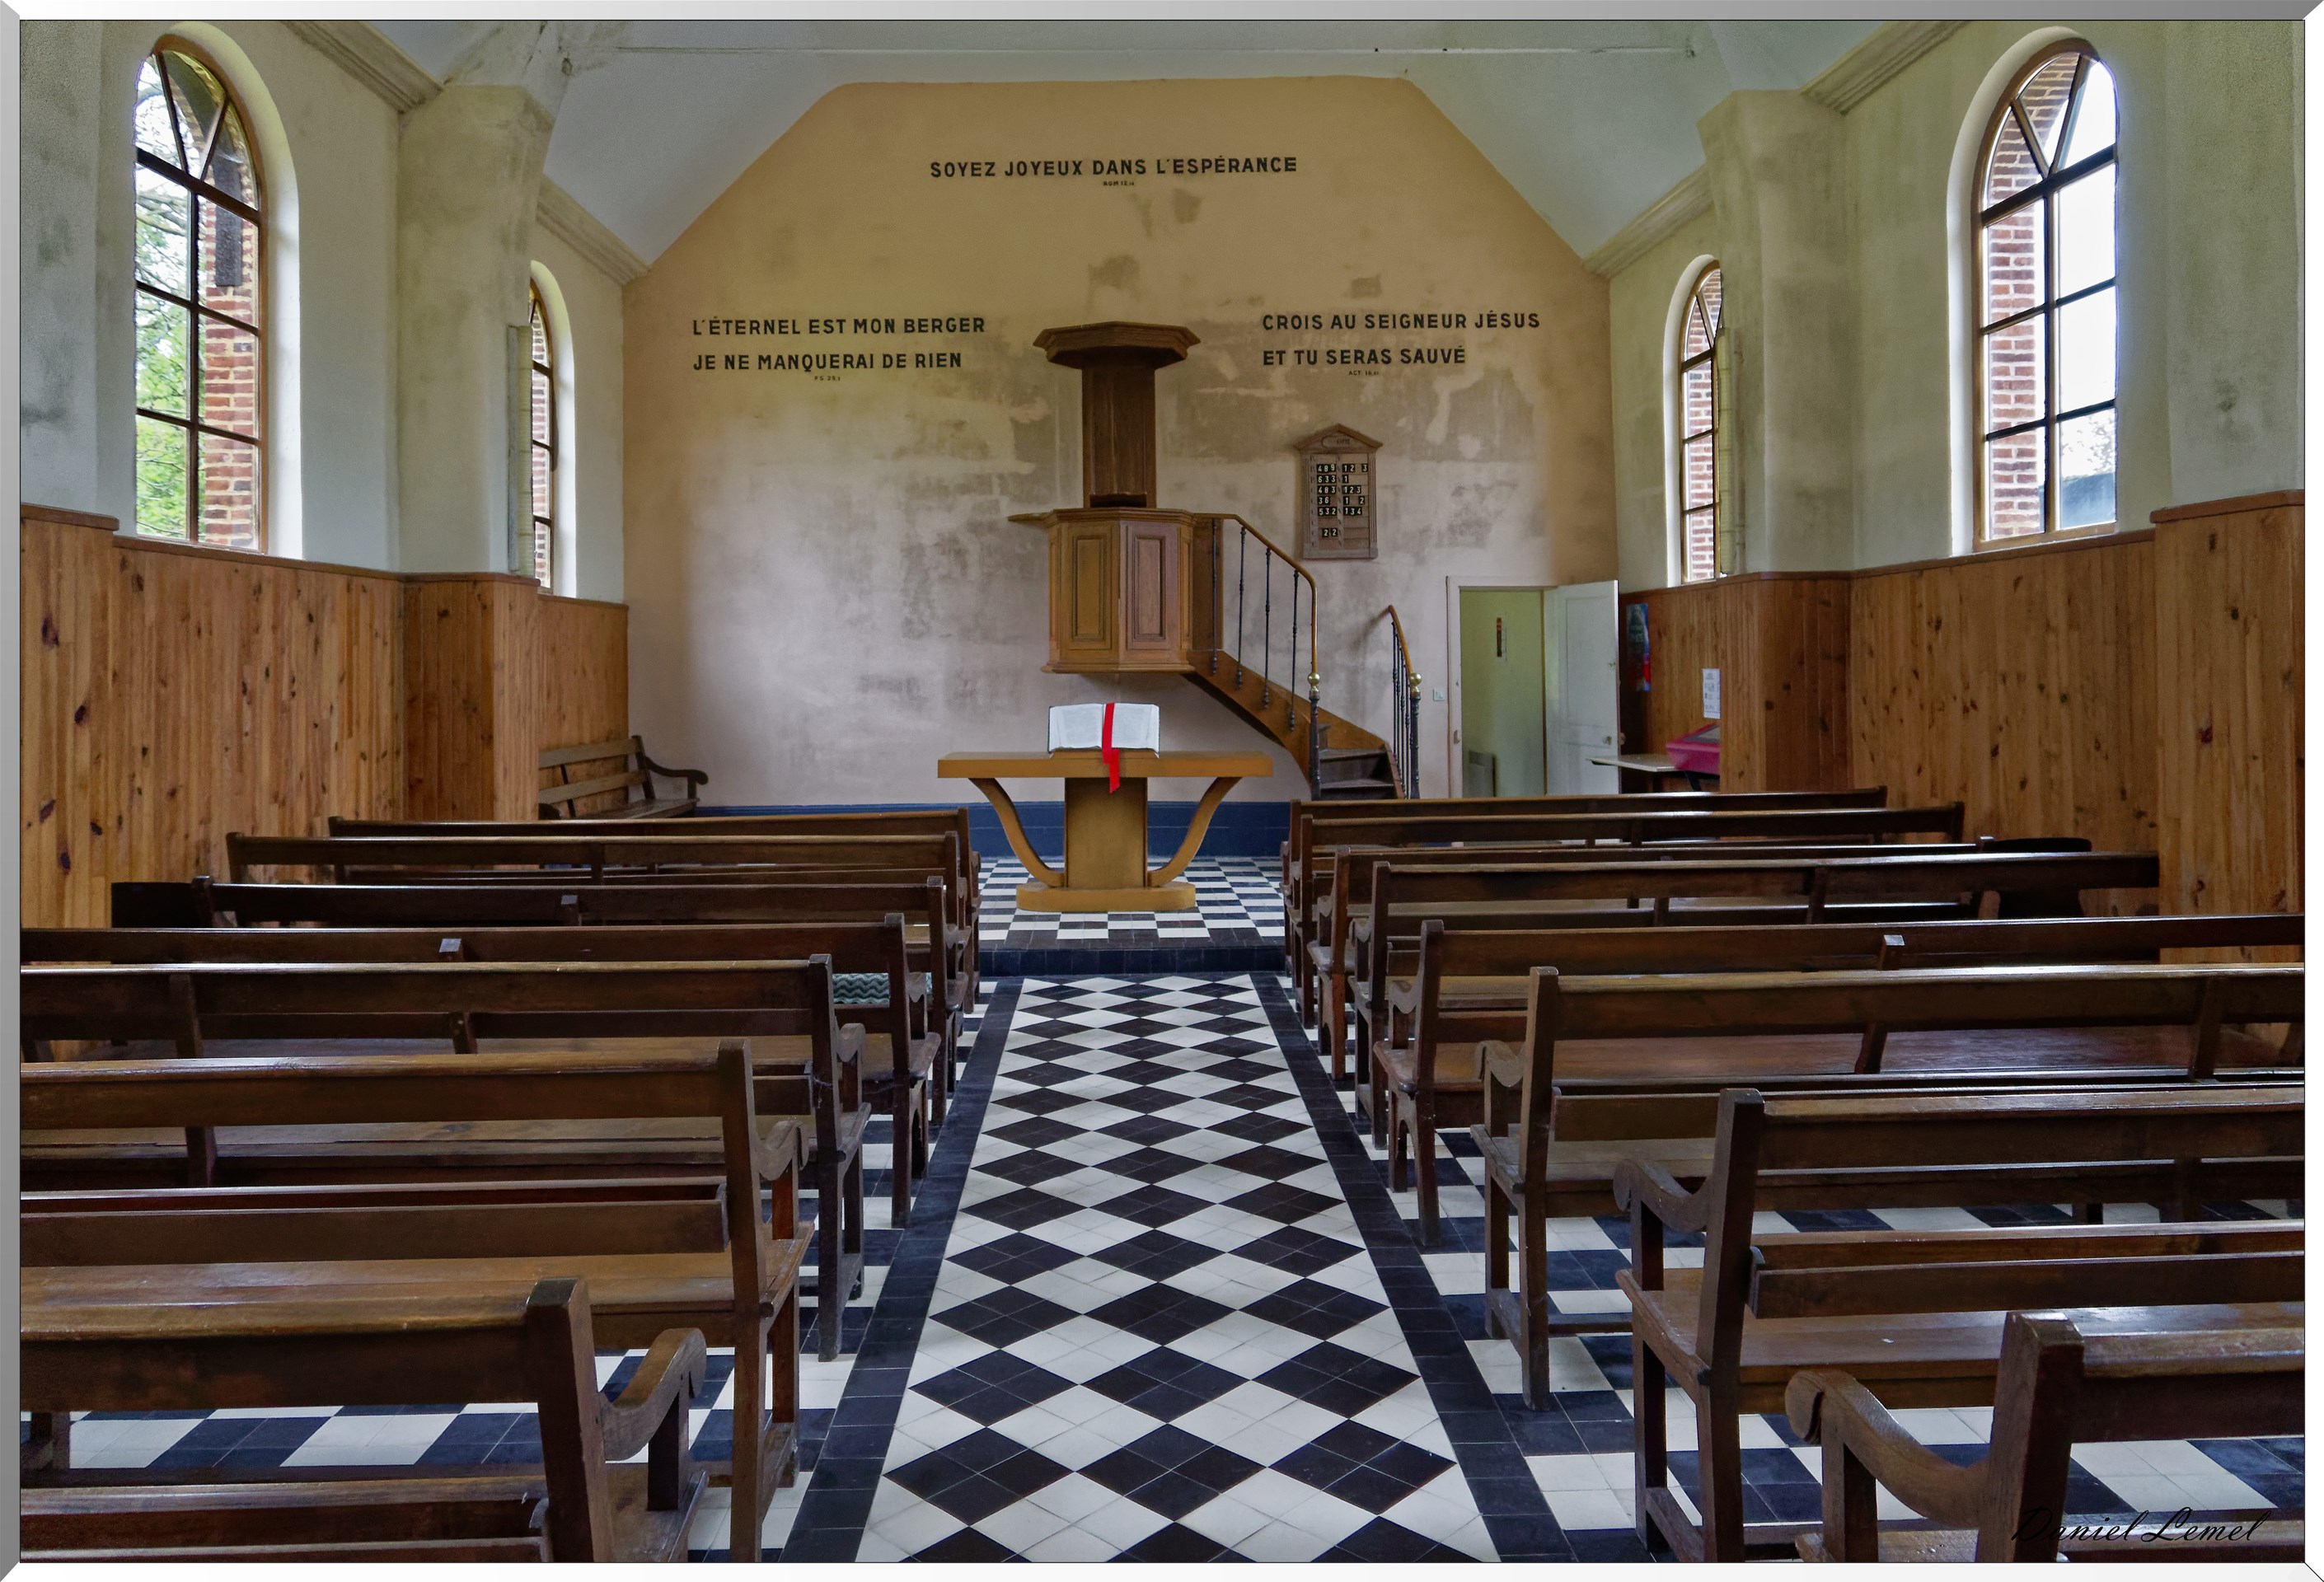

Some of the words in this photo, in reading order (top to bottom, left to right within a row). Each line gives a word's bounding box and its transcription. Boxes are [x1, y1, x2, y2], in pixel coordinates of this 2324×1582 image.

[930, 161, 996, 178] SOYEZ
[1005, 161, 1082, 177] JOYEUX
[1093, 159, 1146, 176] DANS
[1157, 155, 1296, 175] L'ESPÉRANCE
[693, 316, 800, 335] L'ÉTERNEL
[809, 319, 846, 335] EST
[854, 318, 895, 335] MON
[904, 316, 984, 334] BERGER
[1263, 314, 1323, 330] CROIS
[1331, 315, 1356, 330] AU
[1365, 313, 1466, 330] SEIGNEUR
[1475, 310, 1539, 329] JÉSUS
[694, 354, 715, 371] JE
[725, 354, 749, 370] NE
[758, 353, 874, 372] MANQUERAI
[883, 353, 906, 369] DE
[916, 353, 961, 368] RIEN
[1263, 350, 1286, 366] ET
[1294, 350, 1317, 366] TU
[1327, 349, 1391, 365] SERAS
[1401, 345, 1465, 364] SAUVÉ
[1317, 464, 1336, 473] 489
[1318, 475, 1337, 484] 633
[1318, 486, 1337, 494] 483
[1344, 485, 1361, 494] 123
[1319, 497, 1329, 505] 36
[1319, 507, 1337, 516] 532
[1345, 508, 1362, 516] 134
